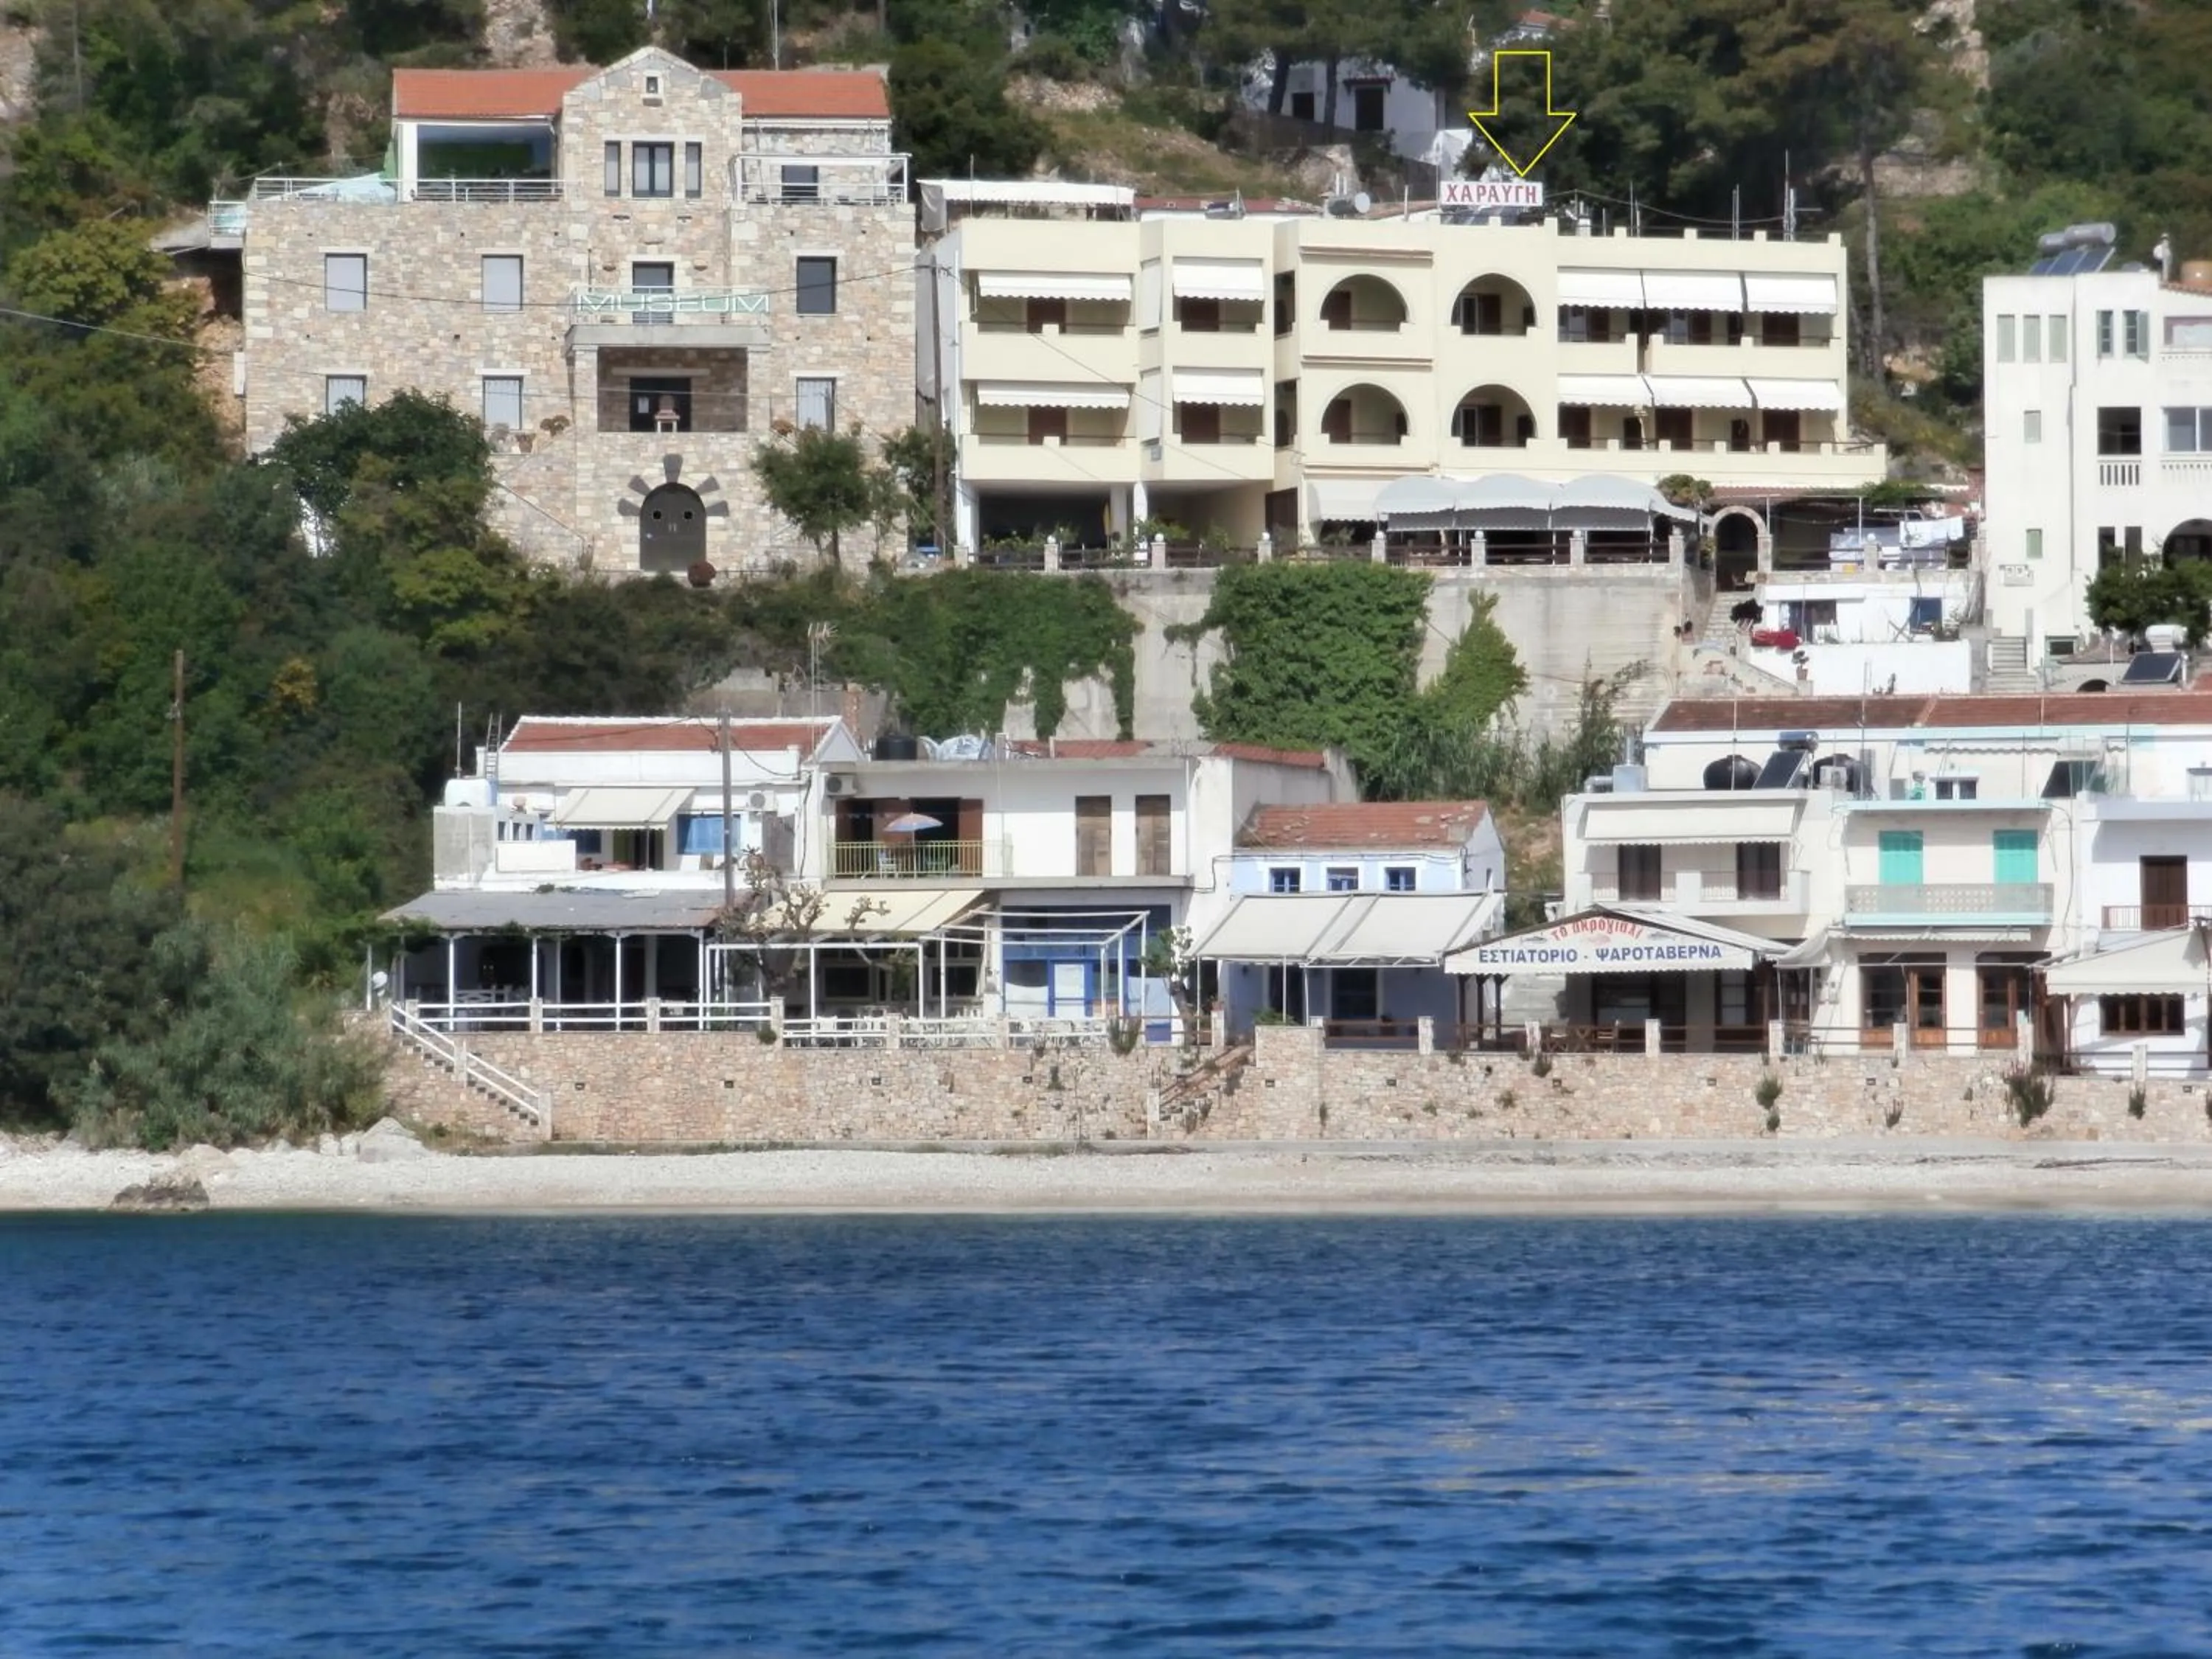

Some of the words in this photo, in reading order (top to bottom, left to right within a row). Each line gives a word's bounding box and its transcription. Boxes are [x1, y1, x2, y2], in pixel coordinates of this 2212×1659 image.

[1447, 184, 1537, 204] ΧΑΡΑΥΓΗ
[577, 294, 770, 312] MUSEUM
[1478, 948, 1578, 963] ΕΣΤΙΑΤΟΡΙΟ
[1596, 945, 1722, 961] ΨΑΡΟΤΑΒΕΡΝΑ
